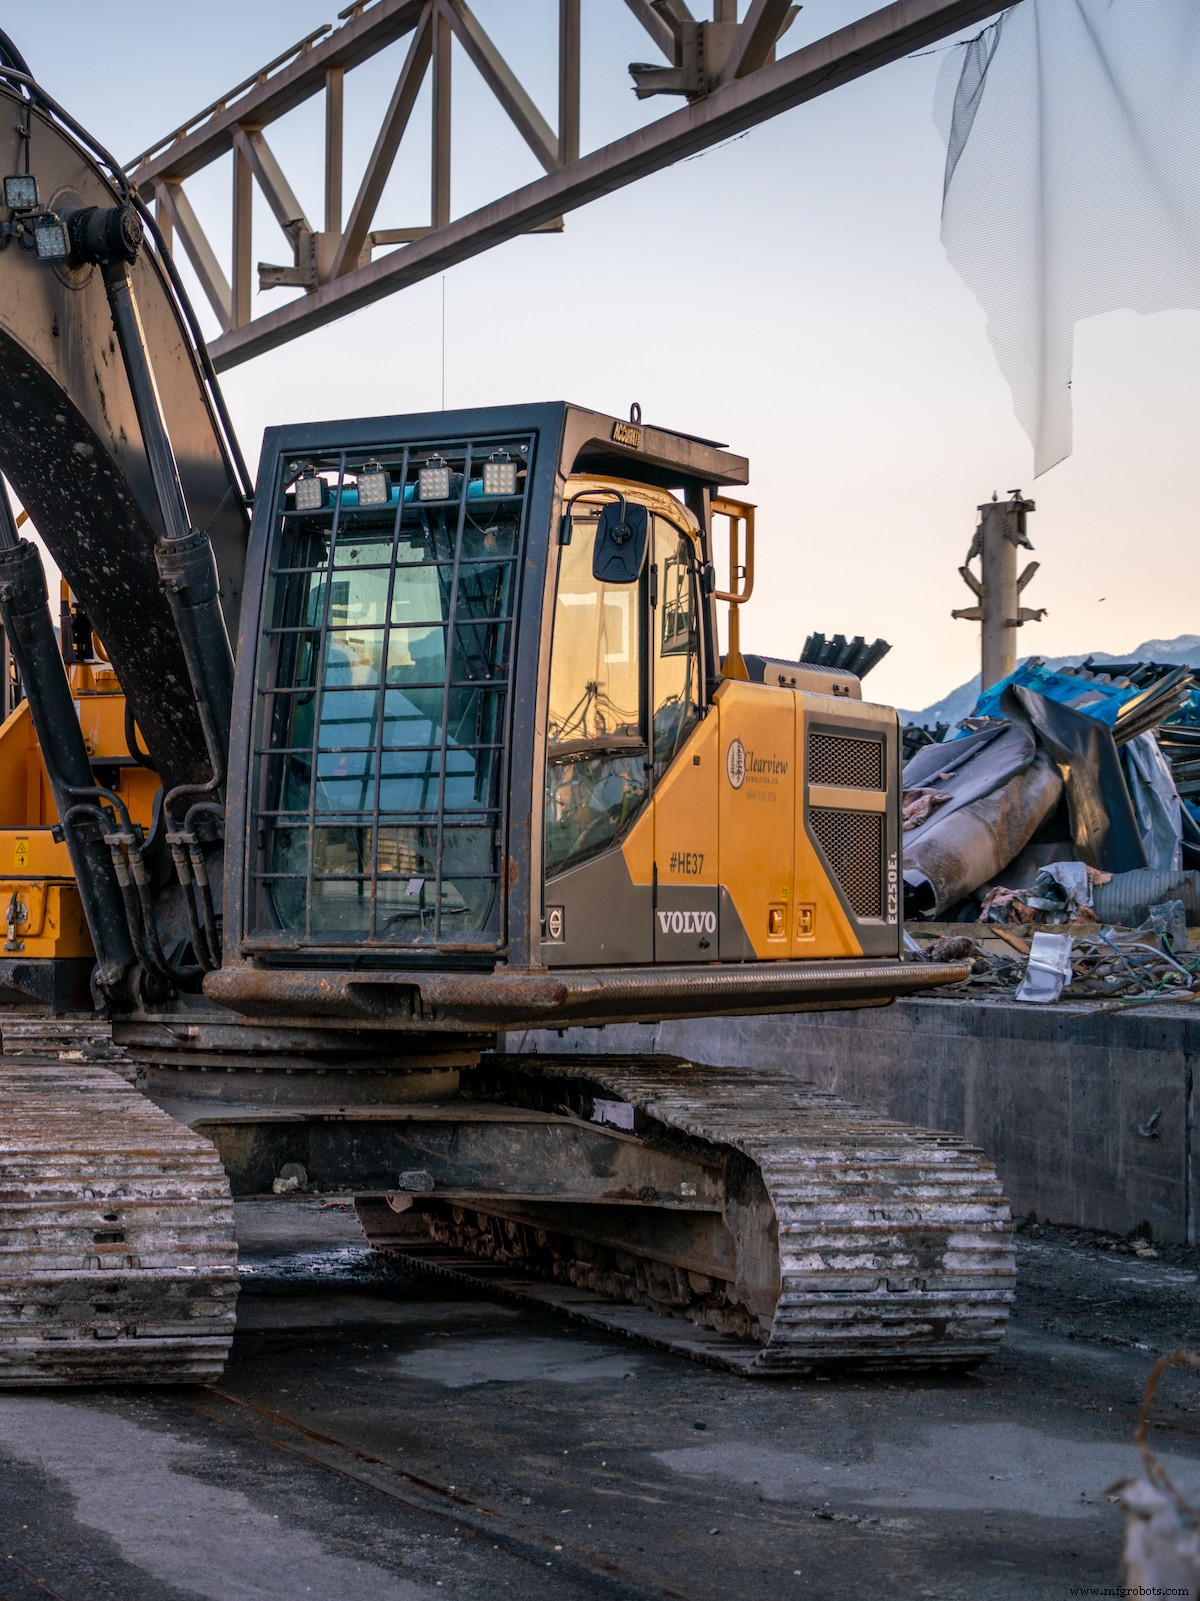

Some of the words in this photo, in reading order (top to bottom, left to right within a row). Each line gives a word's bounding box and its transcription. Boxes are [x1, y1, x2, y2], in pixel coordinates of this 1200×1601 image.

[744, 750, 788, 775] Clearview
[669, 852, 705, 875] #HE37
[657, 911, 717, 934] VOLVO
